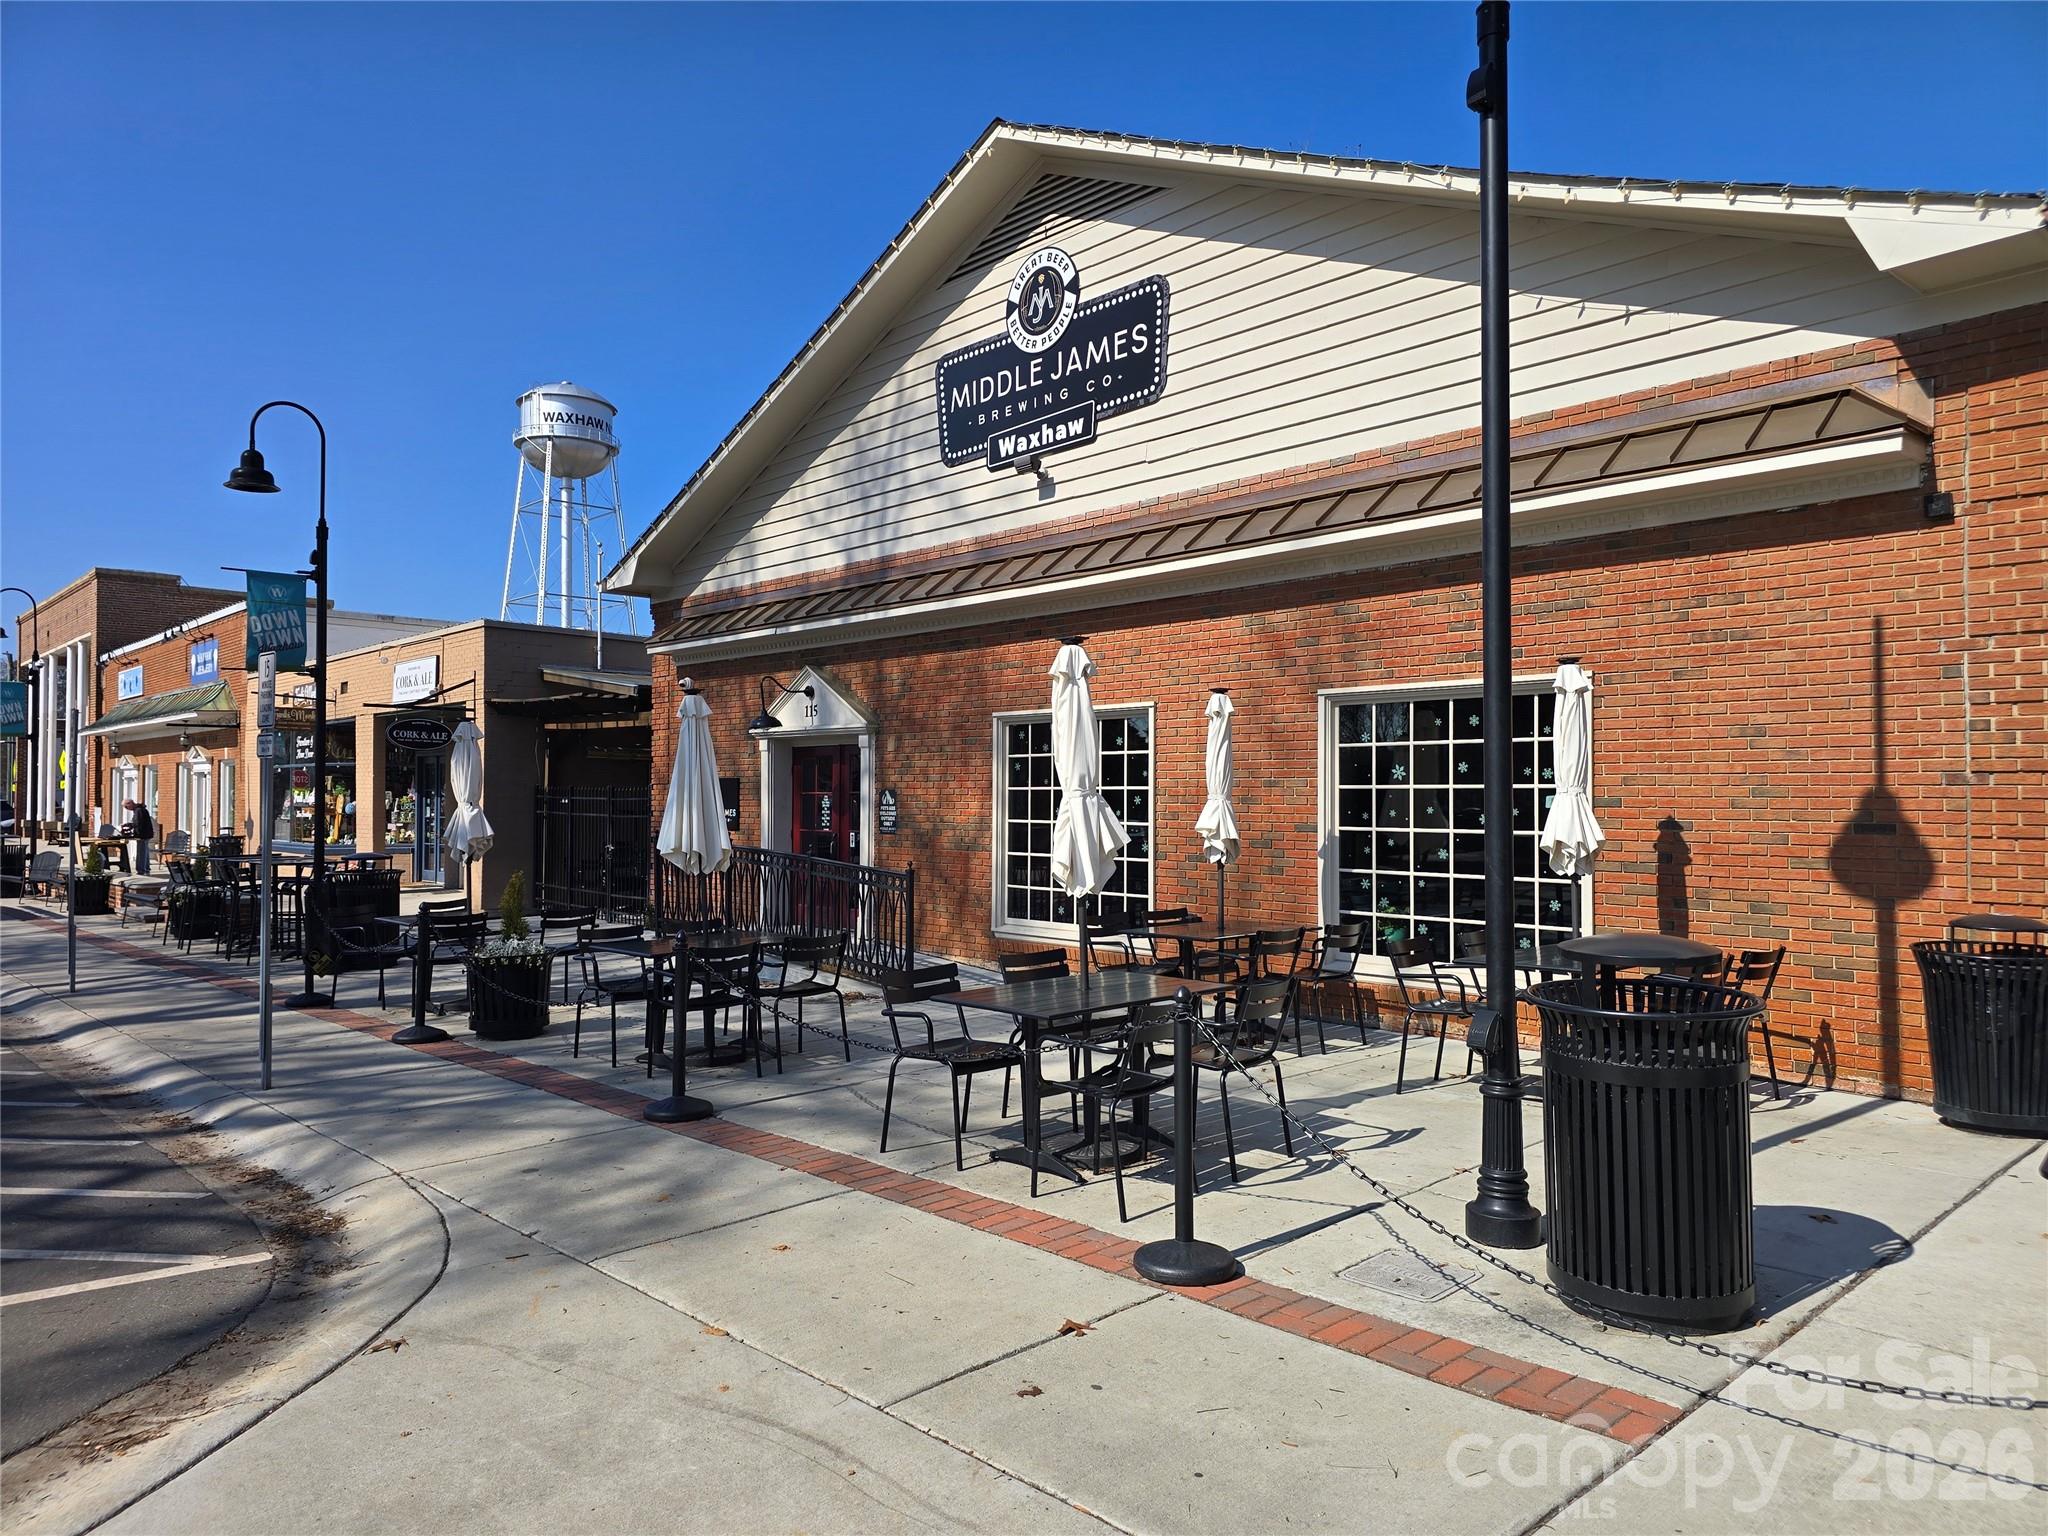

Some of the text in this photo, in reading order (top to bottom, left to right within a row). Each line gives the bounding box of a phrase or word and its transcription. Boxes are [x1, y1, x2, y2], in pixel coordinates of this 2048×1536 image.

[1014, 252, 1070, 291] GREAT BEER
[1010, 302, 1073, 349] BETTER PEOPLE
[950, 323, 1149, 413] MIDDLE JAMES
[978, 388, 1069, 425] BREWING
[998, 417, 1085, 458] Waxhaw
[250, 609, 301, 633] DOWN
[253, 627, 305, 647] TOWN
[264, 658, 270, 678] 15
[395, 671, 433, 690] CORK & ALE
[805, 704, 818, 718] 115
[393, 730, 448, 740] CORK & ALE
